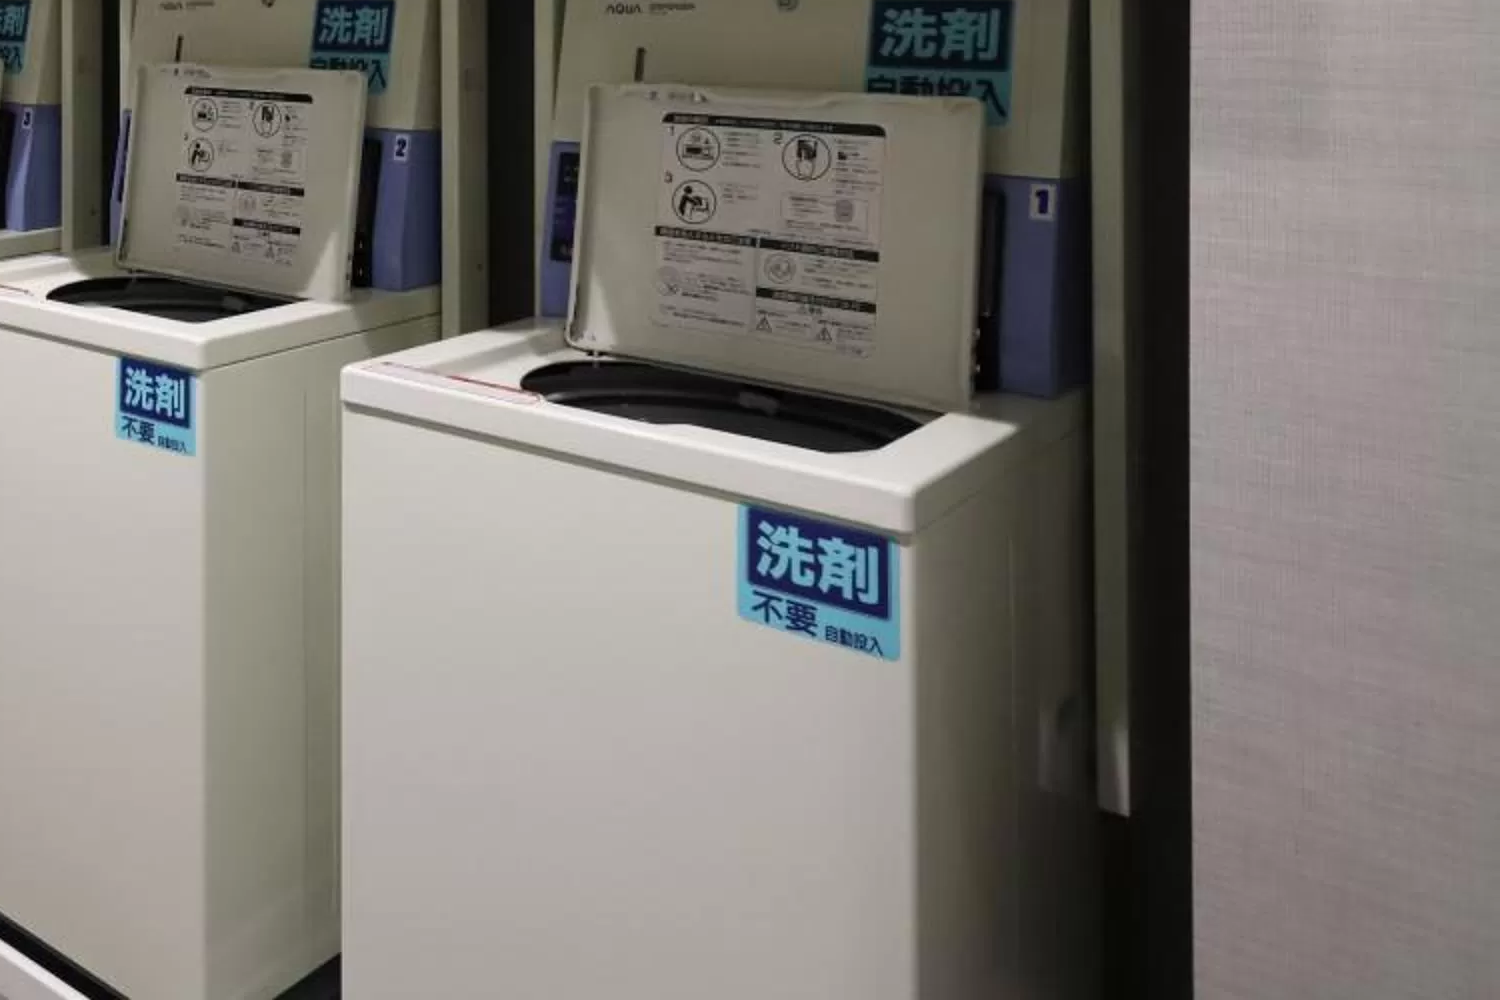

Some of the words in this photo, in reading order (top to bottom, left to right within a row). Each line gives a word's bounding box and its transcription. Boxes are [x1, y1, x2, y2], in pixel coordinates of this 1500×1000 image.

[318, 5, 388, 46] 洗剤
[878, 6, 1001, 61] 洗剤
[394, 138, 407, 158] 2
[1037, 187, 1049, 214] 1
[125, 366, 185, 419] 洗剤
[121, 415, 155, 446] 不要
[756, 519, 879, 605] 洗剤
[751, 589, 819, 637] 不要
[824, 625, 885, 657] 自動投入
